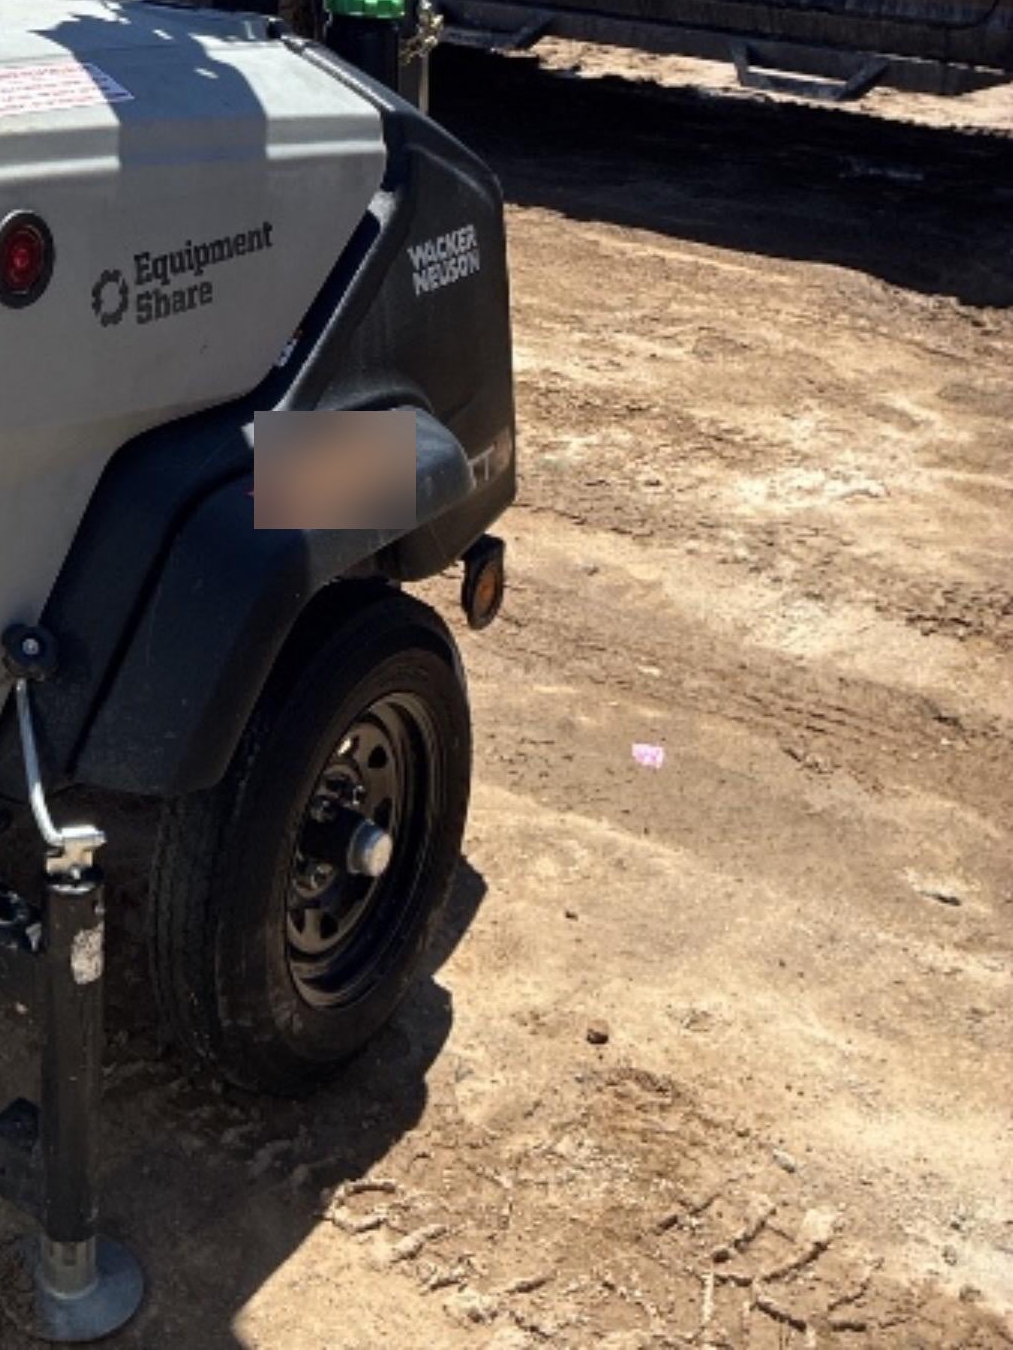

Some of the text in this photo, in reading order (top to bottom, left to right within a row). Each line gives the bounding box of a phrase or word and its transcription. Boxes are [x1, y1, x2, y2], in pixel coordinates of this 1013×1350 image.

[134, 221, 273, 287] Equipment
[407, 224, 478, 271] WACKER
[412, 248, 481, 297] NEUSON
[136, 281, 213, 325] Share
